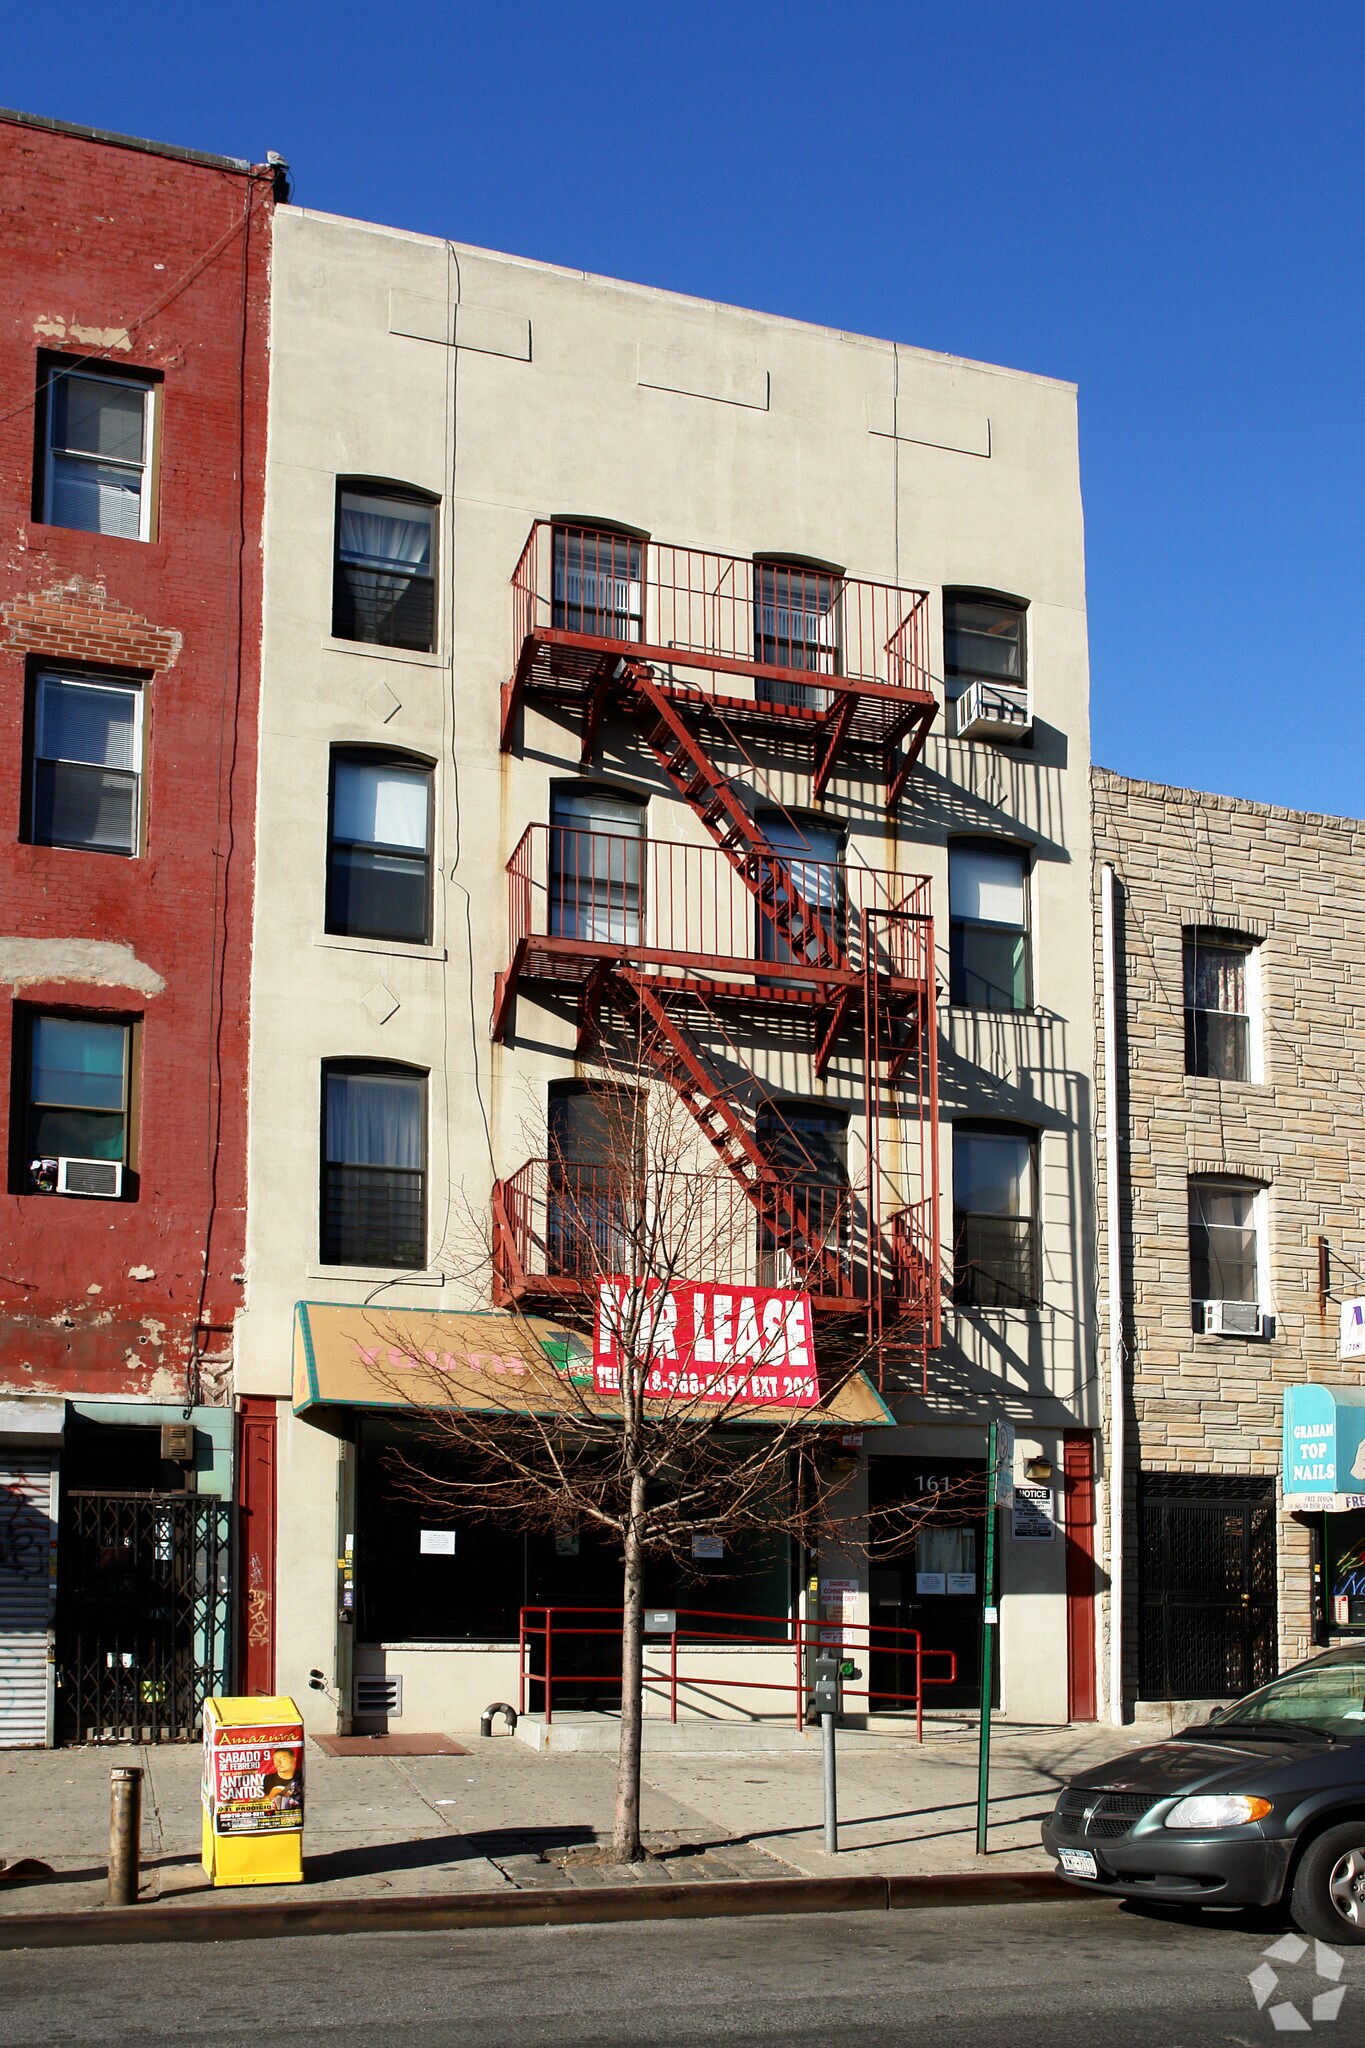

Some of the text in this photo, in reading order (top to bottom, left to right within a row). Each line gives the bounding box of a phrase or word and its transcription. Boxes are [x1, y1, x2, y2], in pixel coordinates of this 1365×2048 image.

[600, 1284, 809, 1367] FOR LEASE
[352, 1344, 525, 1376] YOUTH
[751, 1376, 778, 1397] EXT
[783, 1376, 814, 1398] 209
[1293, 1423, 1334, 1439] GRAHAM
[1300, 1442, 1327, 1460] TOP
[1293, 1463, 1335, 1481] NAILS
[914, 1475, 949, 1492] 161
[1020, 1490, 1047, 1498] NOTICE
[218, 1750, 270, 1763] SABADO 9
[219, 1761, 260, 1771] DE FEBRERO
[220, 1773, 266, 1788] ANTONY
[220, 1786, 265, 1800] SANTOS
